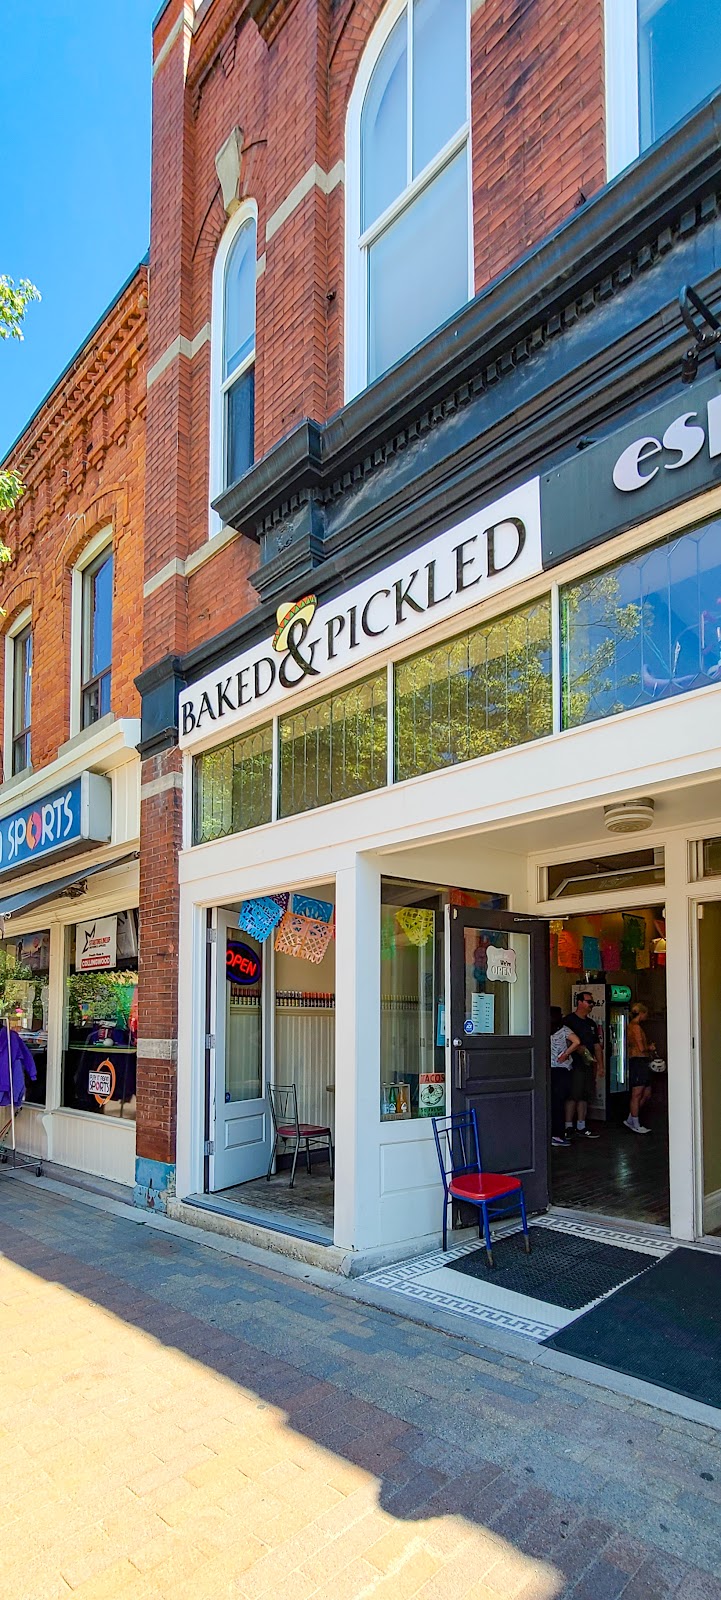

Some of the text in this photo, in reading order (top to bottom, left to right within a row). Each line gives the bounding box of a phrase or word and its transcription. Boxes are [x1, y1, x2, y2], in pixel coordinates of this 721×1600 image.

[612, 394, 721, 492] es
[181, 516, 527, 736] BAKED & PICKLED
[7, 791, 73, 861] SPORTS
[82, 957, 110, 967] COLLINGWOOD
[226, 950, 256, 977] OPEN
[491, 965, 512, 976] OPEN
[90, 1080, 109, 1092] SPORTS
[421, 1074, 446, 1083] TACOS
